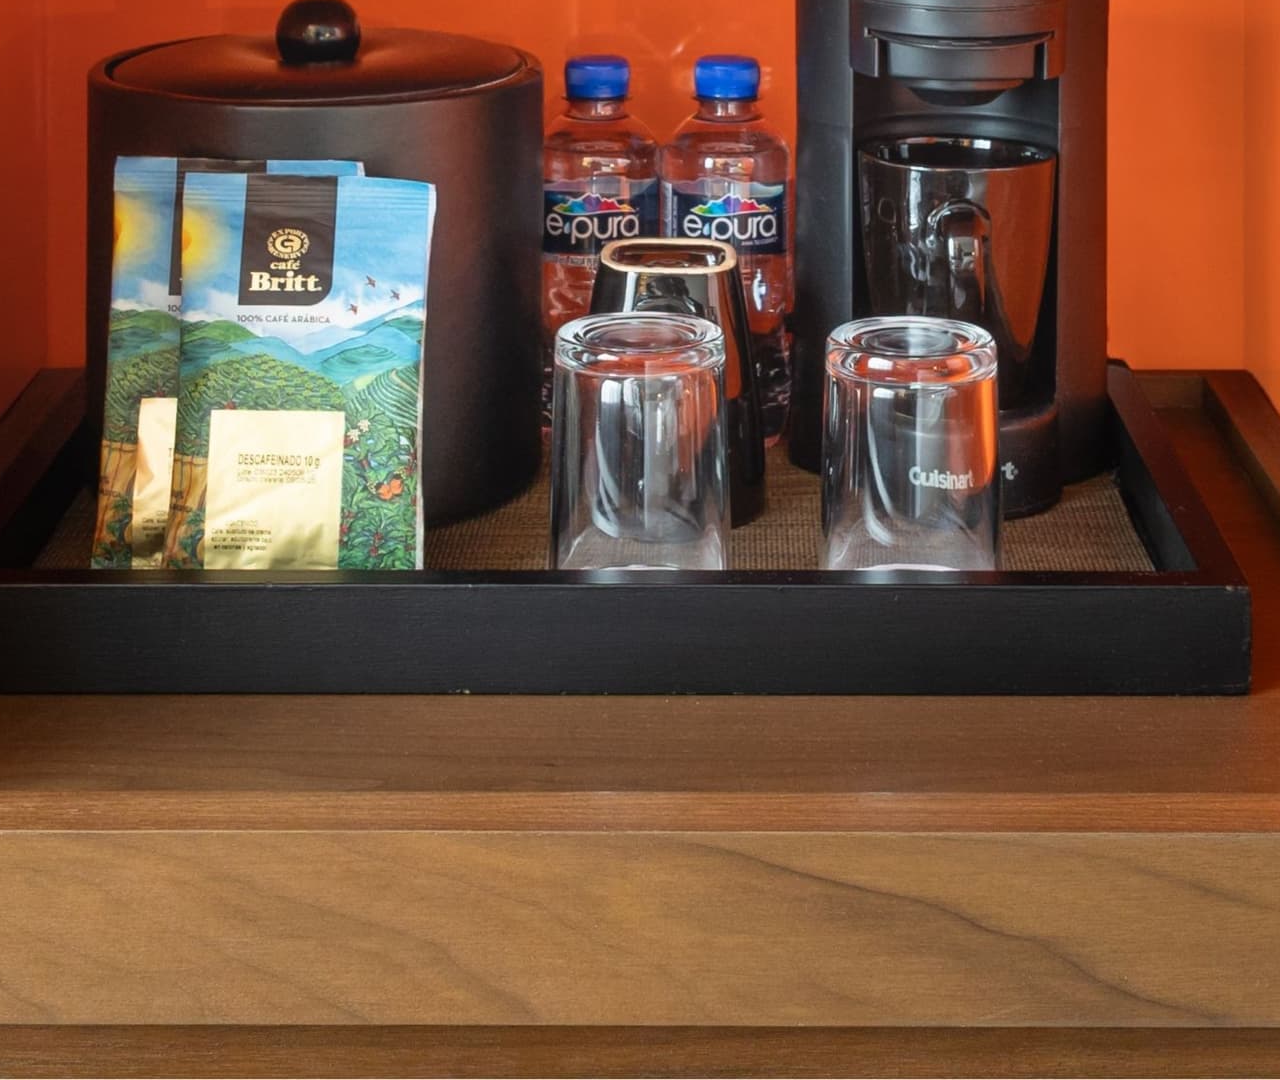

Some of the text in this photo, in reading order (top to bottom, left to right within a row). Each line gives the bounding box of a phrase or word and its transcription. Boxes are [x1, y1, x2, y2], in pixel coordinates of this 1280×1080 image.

[270, 260, 300, 270] café
[237, 315, 330, 323] 100% CAFÉ ARÁBICA
[238, 454, 301, 466] DESCAFEINADO
[305, 456, 313, 467] 10
[909, 466, 973, 489] Cuisinart
